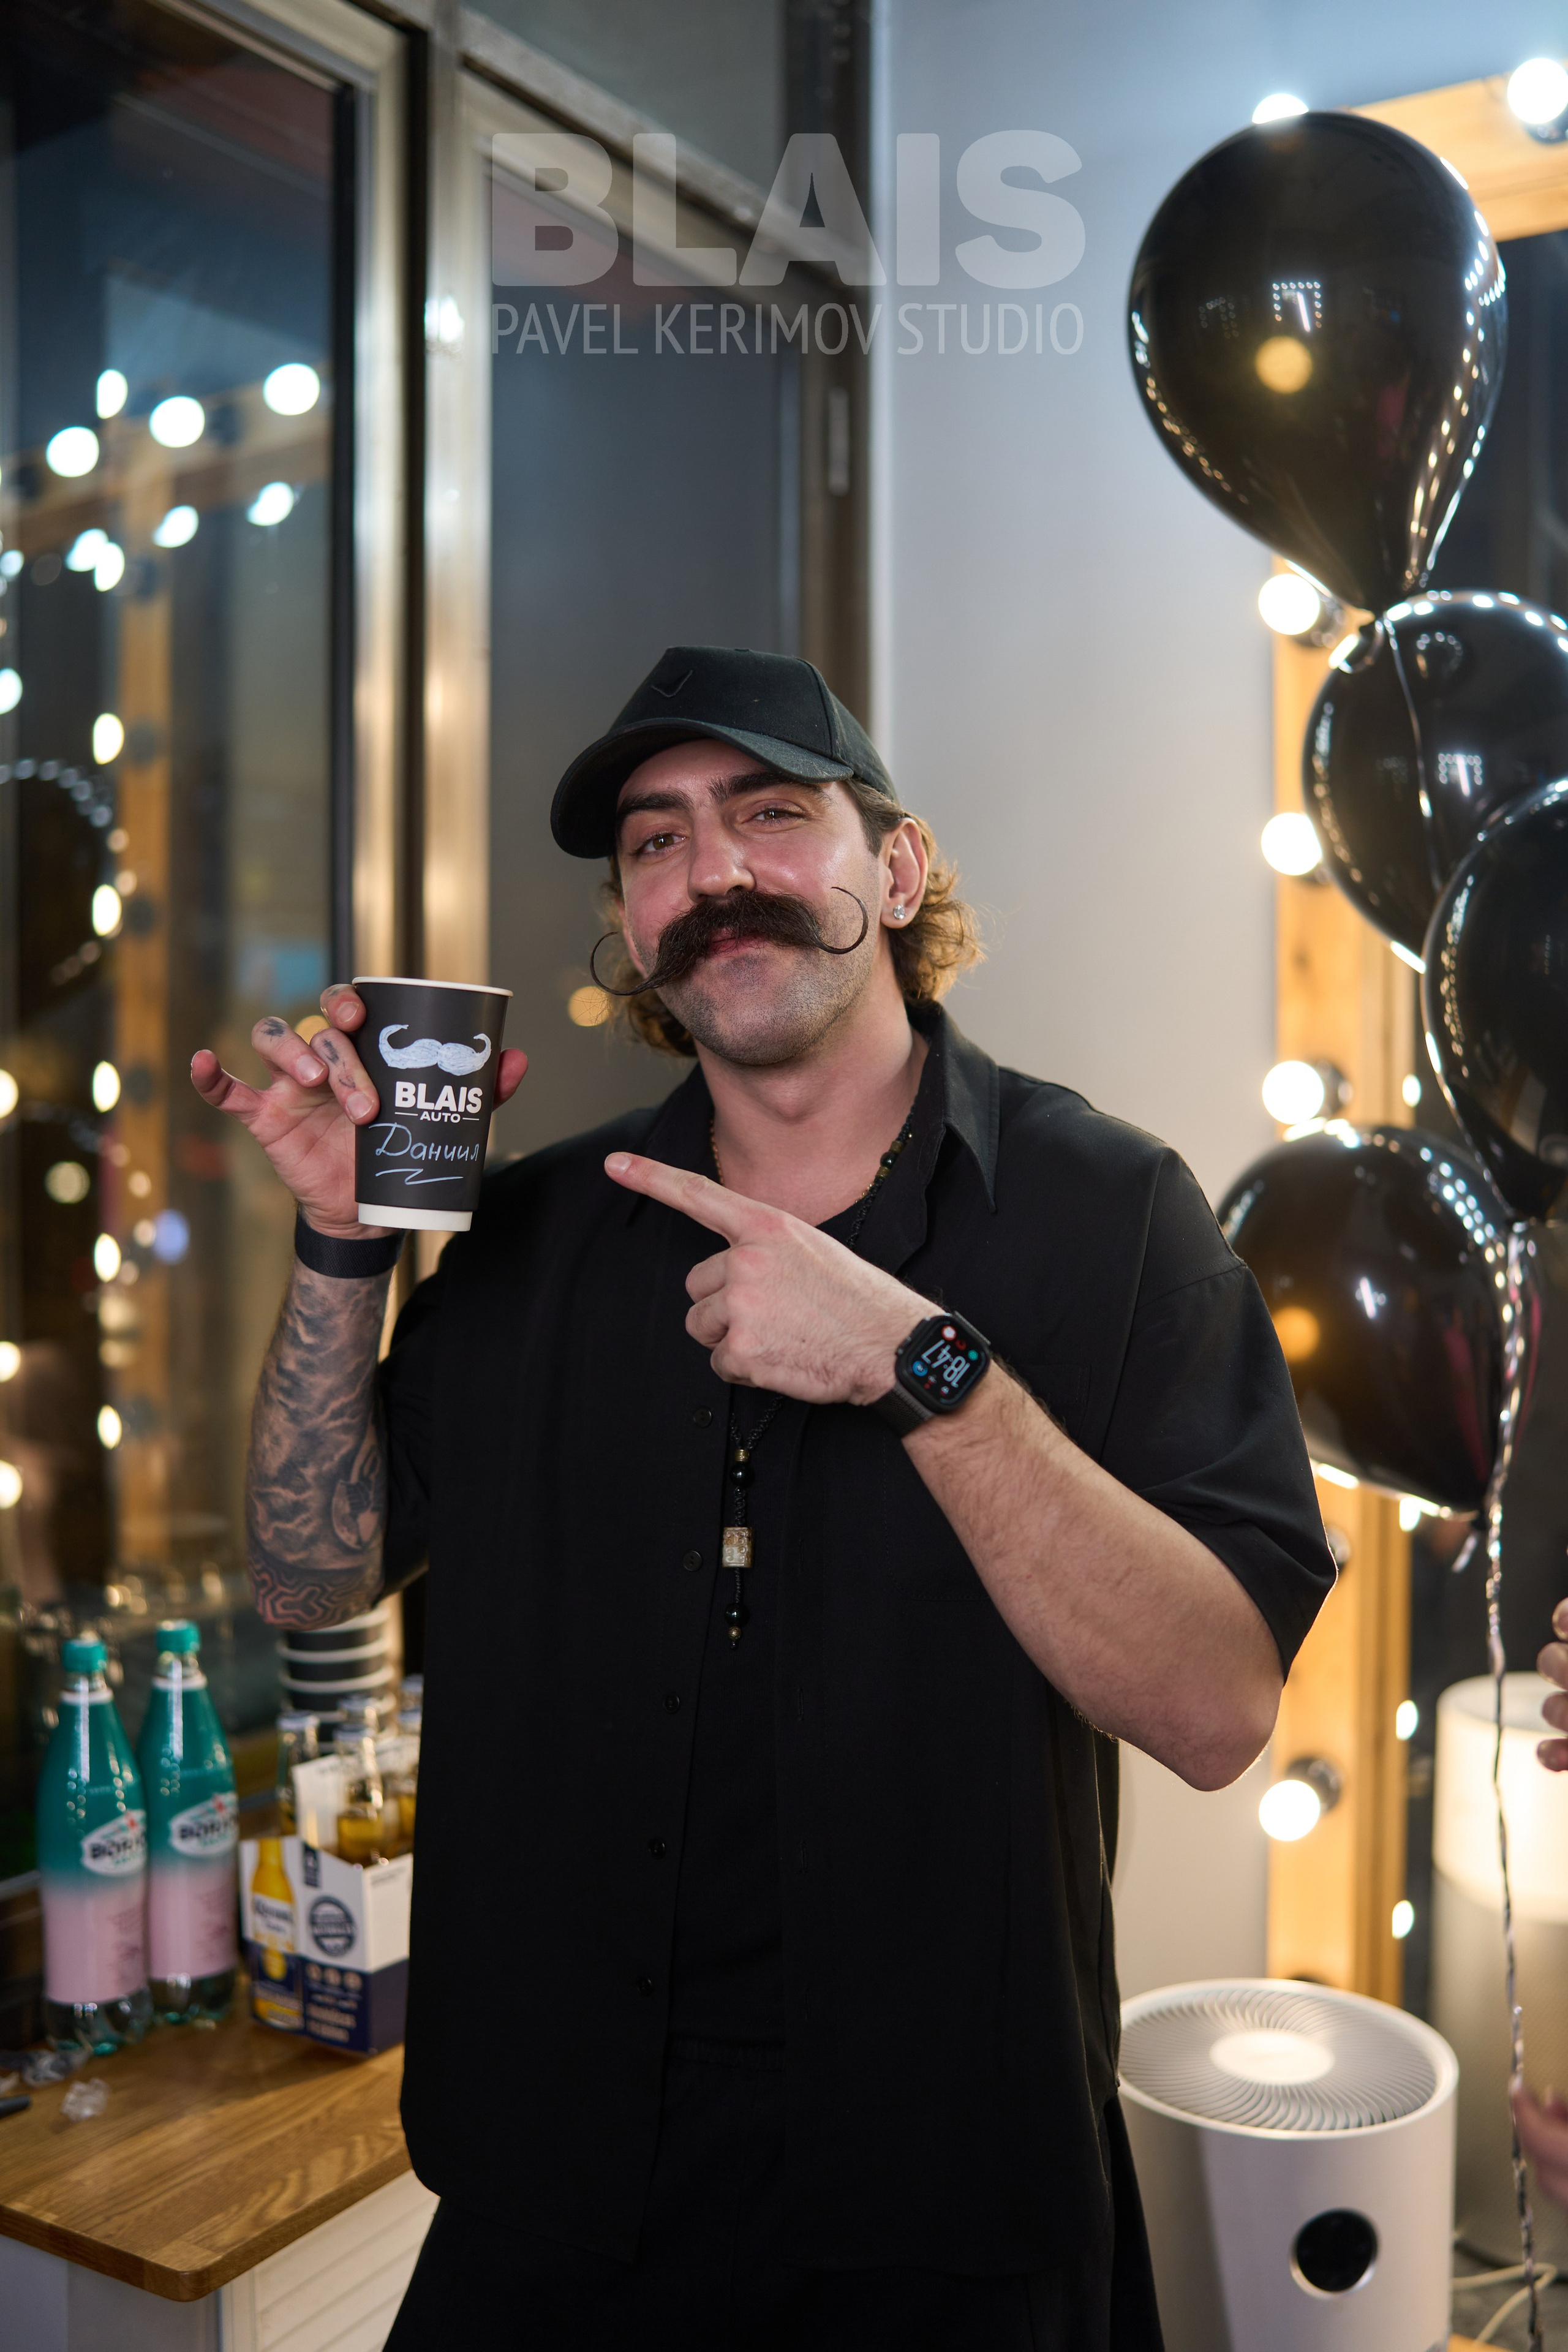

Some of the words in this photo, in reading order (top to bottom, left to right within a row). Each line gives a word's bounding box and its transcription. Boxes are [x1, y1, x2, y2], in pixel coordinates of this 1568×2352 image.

[394, 1081, 483, 1114] BLAIS
[420, 1111, 461, 1123] AUTO
[369, 1122, 480, 1161] Даниил
[921, 1339, 970, 1388] 18:47
